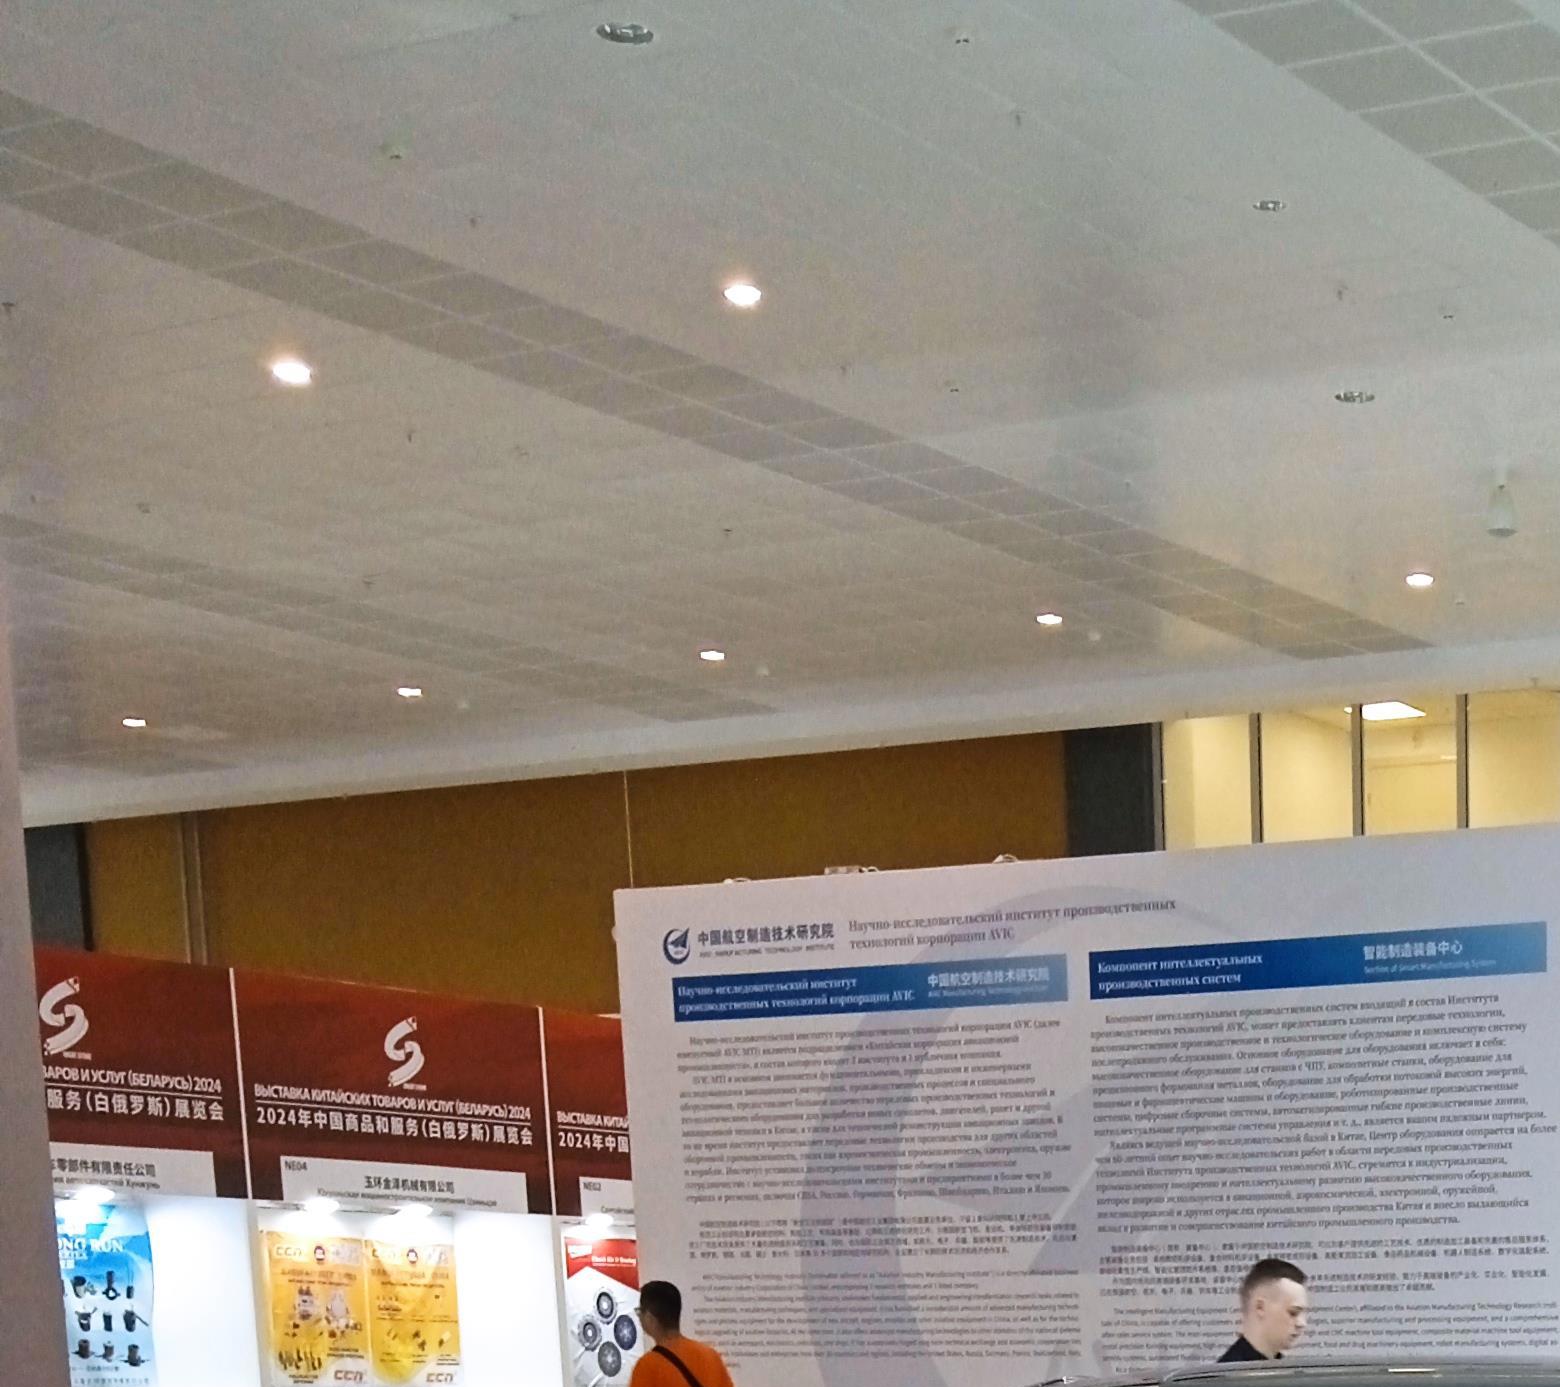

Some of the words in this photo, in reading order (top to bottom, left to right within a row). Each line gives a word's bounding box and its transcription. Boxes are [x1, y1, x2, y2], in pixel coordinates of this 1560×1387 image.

[92, 1068, 127, 1085] УСЛУГ
[128, 1070, 193, 1091] (БЕЛАРУСЬ)
[194, 1076, 222, 1094] 2024
[254, 1083, 310, 1100] ВЫСТАВКА
[311, 1086, 371, 1106] КИТАЙСКИХ
[371, 1093, 417, 1111] ТОВАРОВ
[426, 1098, 455, 1113] УСЛУГ
[455, 1099, 508, 1118] (БЕЛАРУСЬ)
[508, 1105, 531, 1120] 2024
[557, 1111, 601, 1127] ВЫСТАВКА
[285, 1160, 308, 1172] NE04
